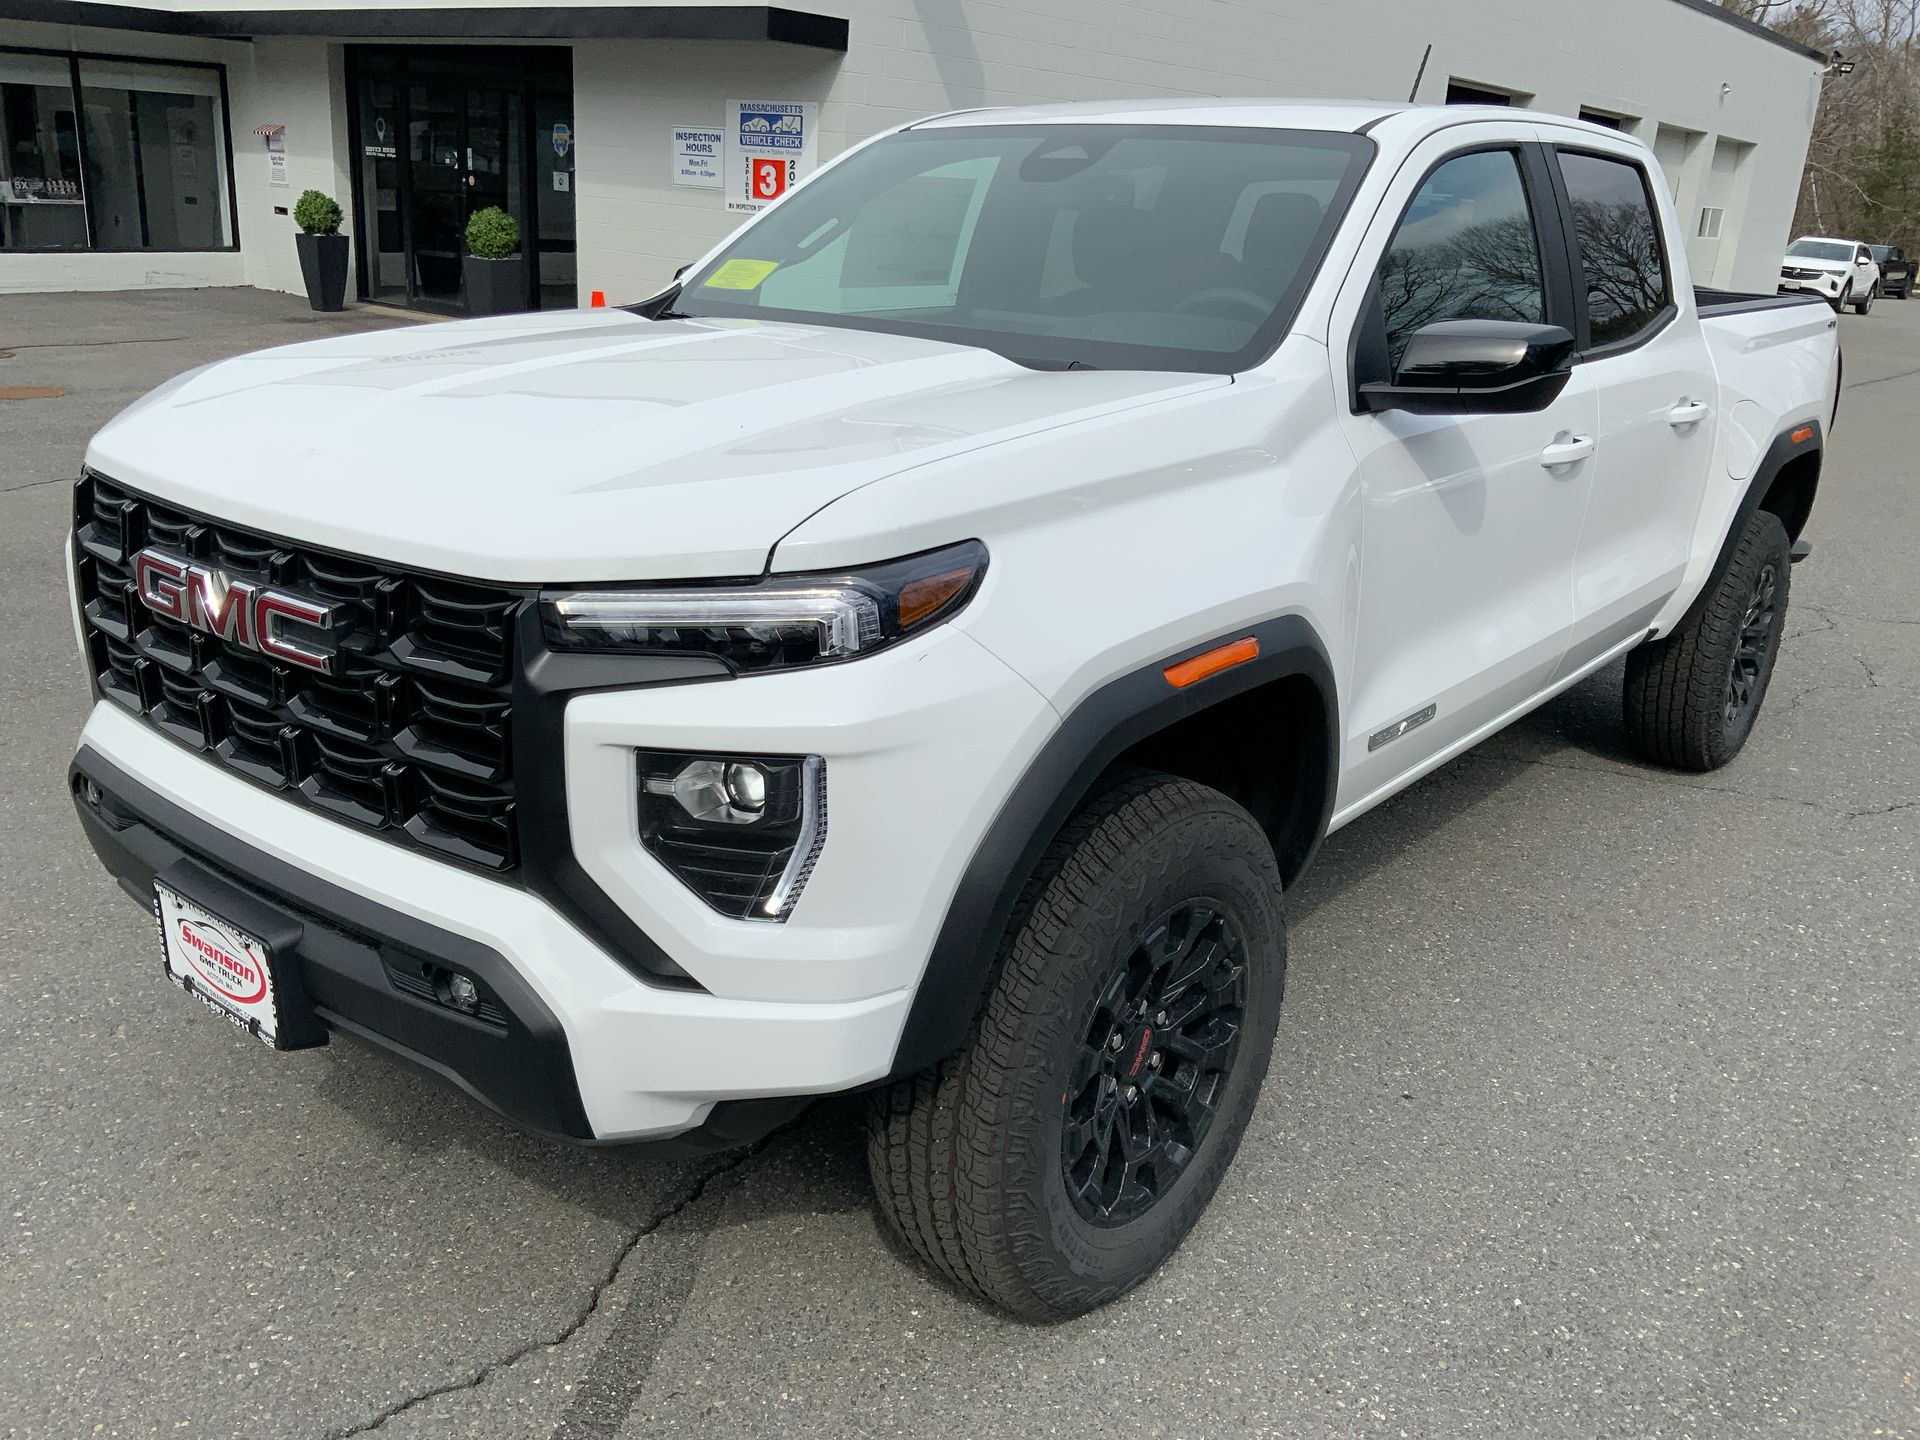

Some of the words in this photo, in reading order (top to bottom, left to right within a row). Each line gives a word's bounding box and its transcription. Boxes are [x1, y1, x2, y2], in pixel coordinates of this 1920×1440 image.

[740, 103, 803, 114] MASSACHUSETTS
[675, 132, 721, 143] INSPECTION
[685, 143, 713, 153] HOURS
[741, 135, 772, 146] VEHICLE
[774, 137, 801, 148] CHECK
[760, 165, 777, 196] 3
[137, 549, 333, 675] GMC
[182, 925, 255, 984] Swanson
[199, 955, 216, 971] GMC
[218, 965, 243, 988] TRUCK
